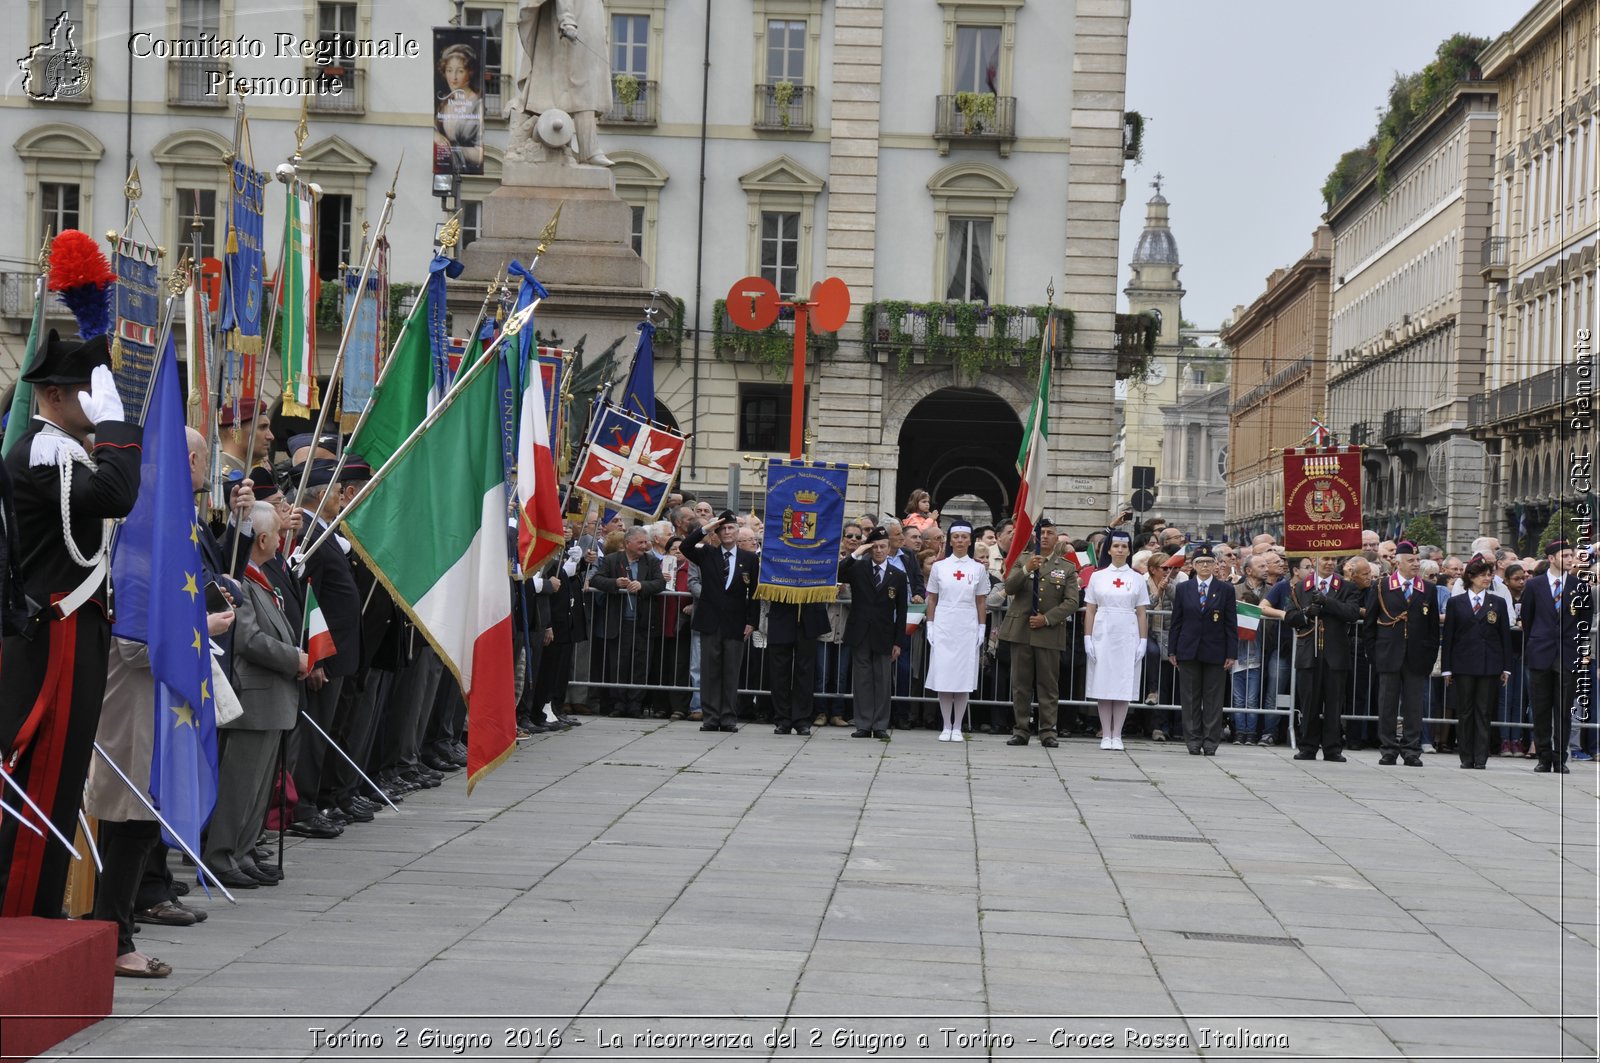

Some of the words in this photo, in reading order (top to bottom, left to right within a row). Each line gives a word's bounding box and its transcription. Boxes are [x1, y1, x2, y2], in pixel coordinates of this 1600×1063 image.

[741, 291, 765, 320] T
[1317, 523, 1359, 531] PROVINCIALE
[1307, 539, 1342, 548] TORINO
[771, 575, 797, 583] Sezione
